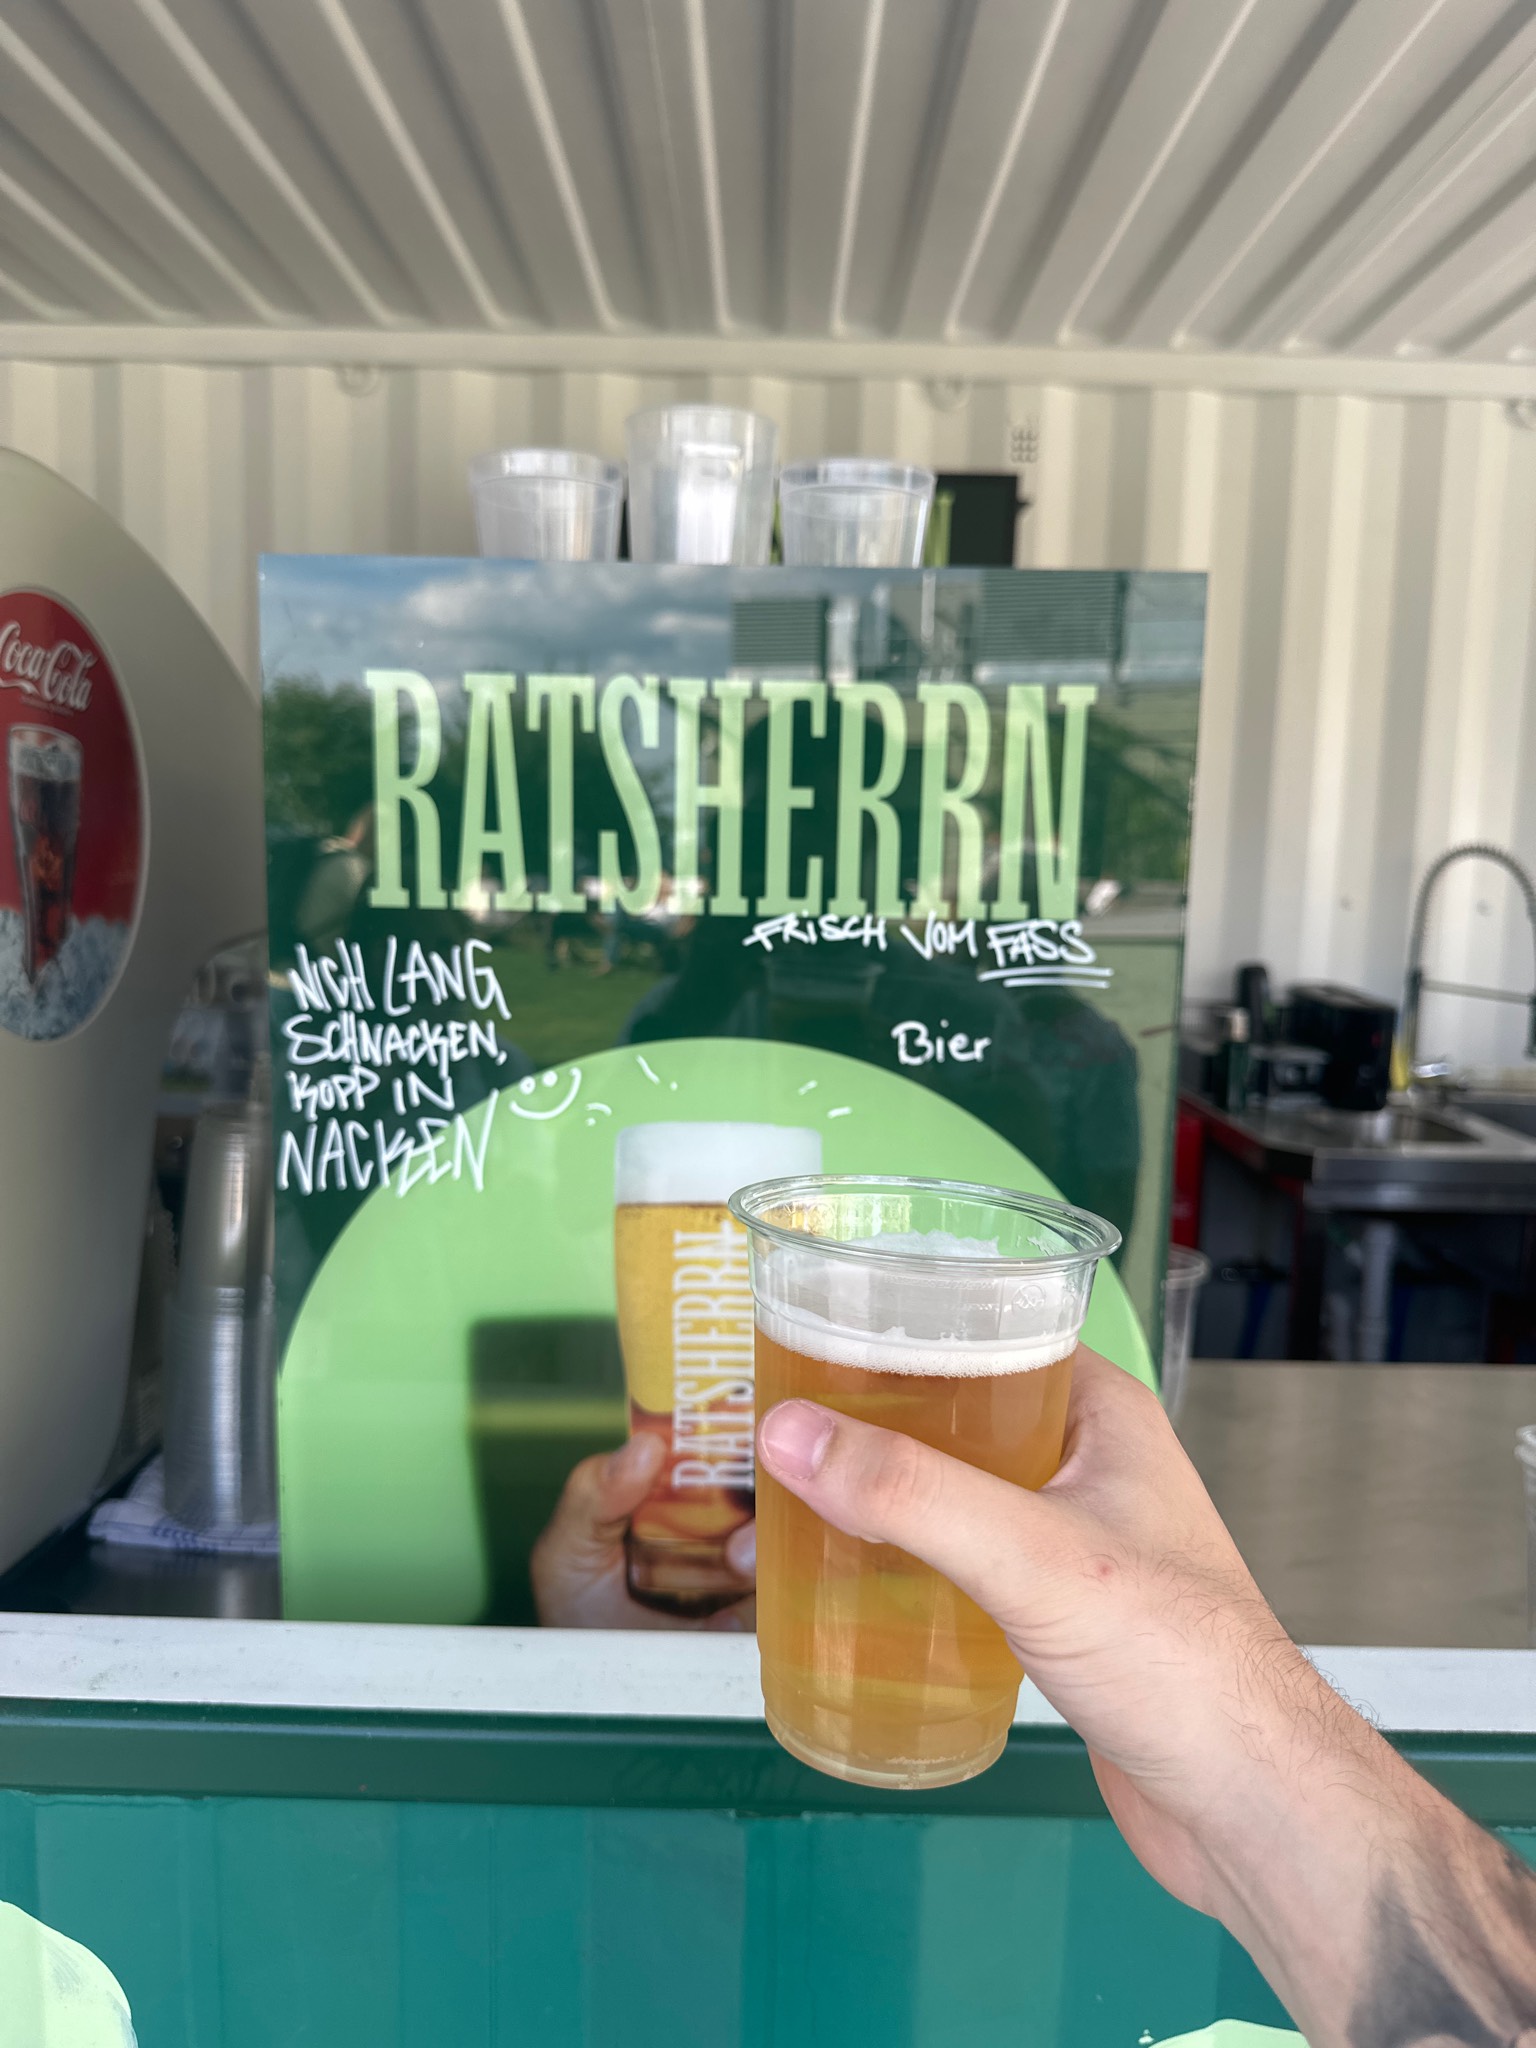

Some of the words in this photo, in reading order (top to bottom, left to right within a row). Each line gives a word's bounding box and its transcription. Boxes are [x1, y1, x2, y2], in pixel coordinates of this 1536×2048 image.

[364, 669, 1098, 920] RATSHERRN
[383, 935, 512, 1020] LANG
[900, 910, 979, 960] VOM
[986, 919, 1097, 968] FASS
[282, 1010, 507, 1080] SCHNACKEN,
[891, 1019, 992, 1066] Bier
[286, 1062, 381, 1121] KOPP
[393, 1070, 455, 1115] IN
[277, 1088, 500, 1197] NACKEN
[672, 1221, 755, 1490] RATSHERRN
